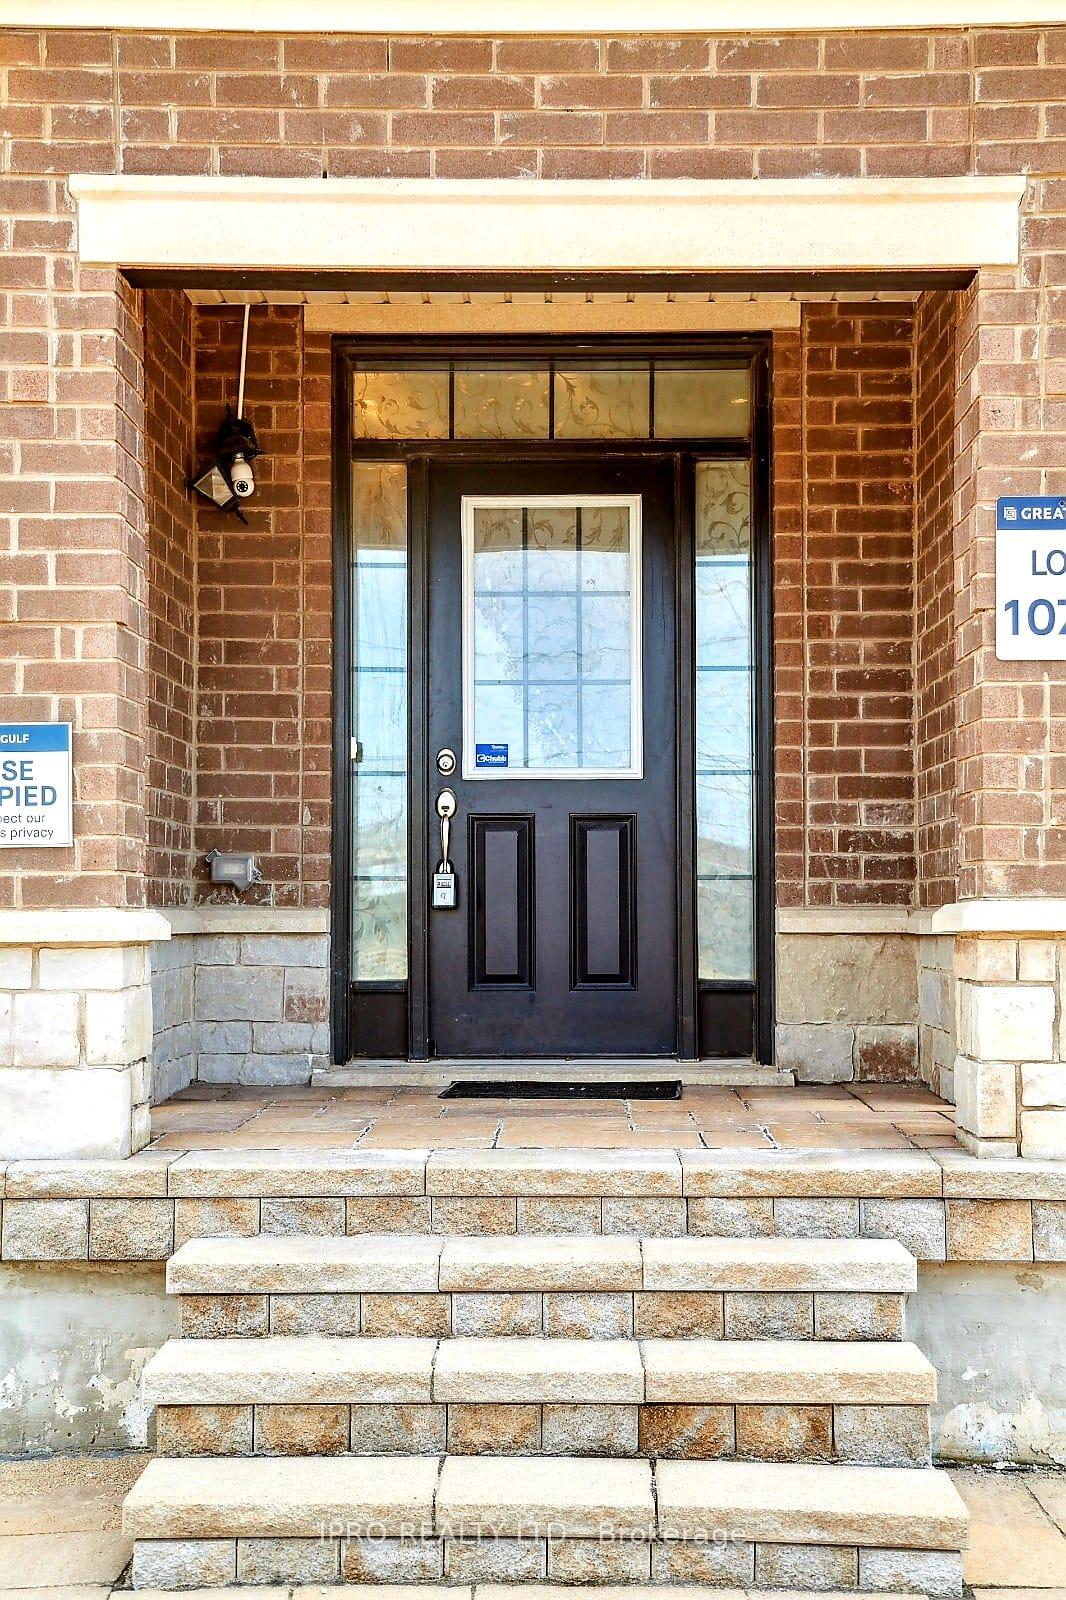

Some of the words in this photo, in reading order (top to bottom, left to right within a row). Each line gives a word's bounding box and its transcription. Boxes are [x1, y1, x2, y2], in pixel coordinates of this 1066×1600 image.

[0, 733, 30, 744] GULF
[1, 759, 34, 781] SE
[0, 785, 57, 807] PIED
[0, 813, 22, 823] ect
[26, 814, 46, 823] our
[10, 827, 54, 840] privacy
